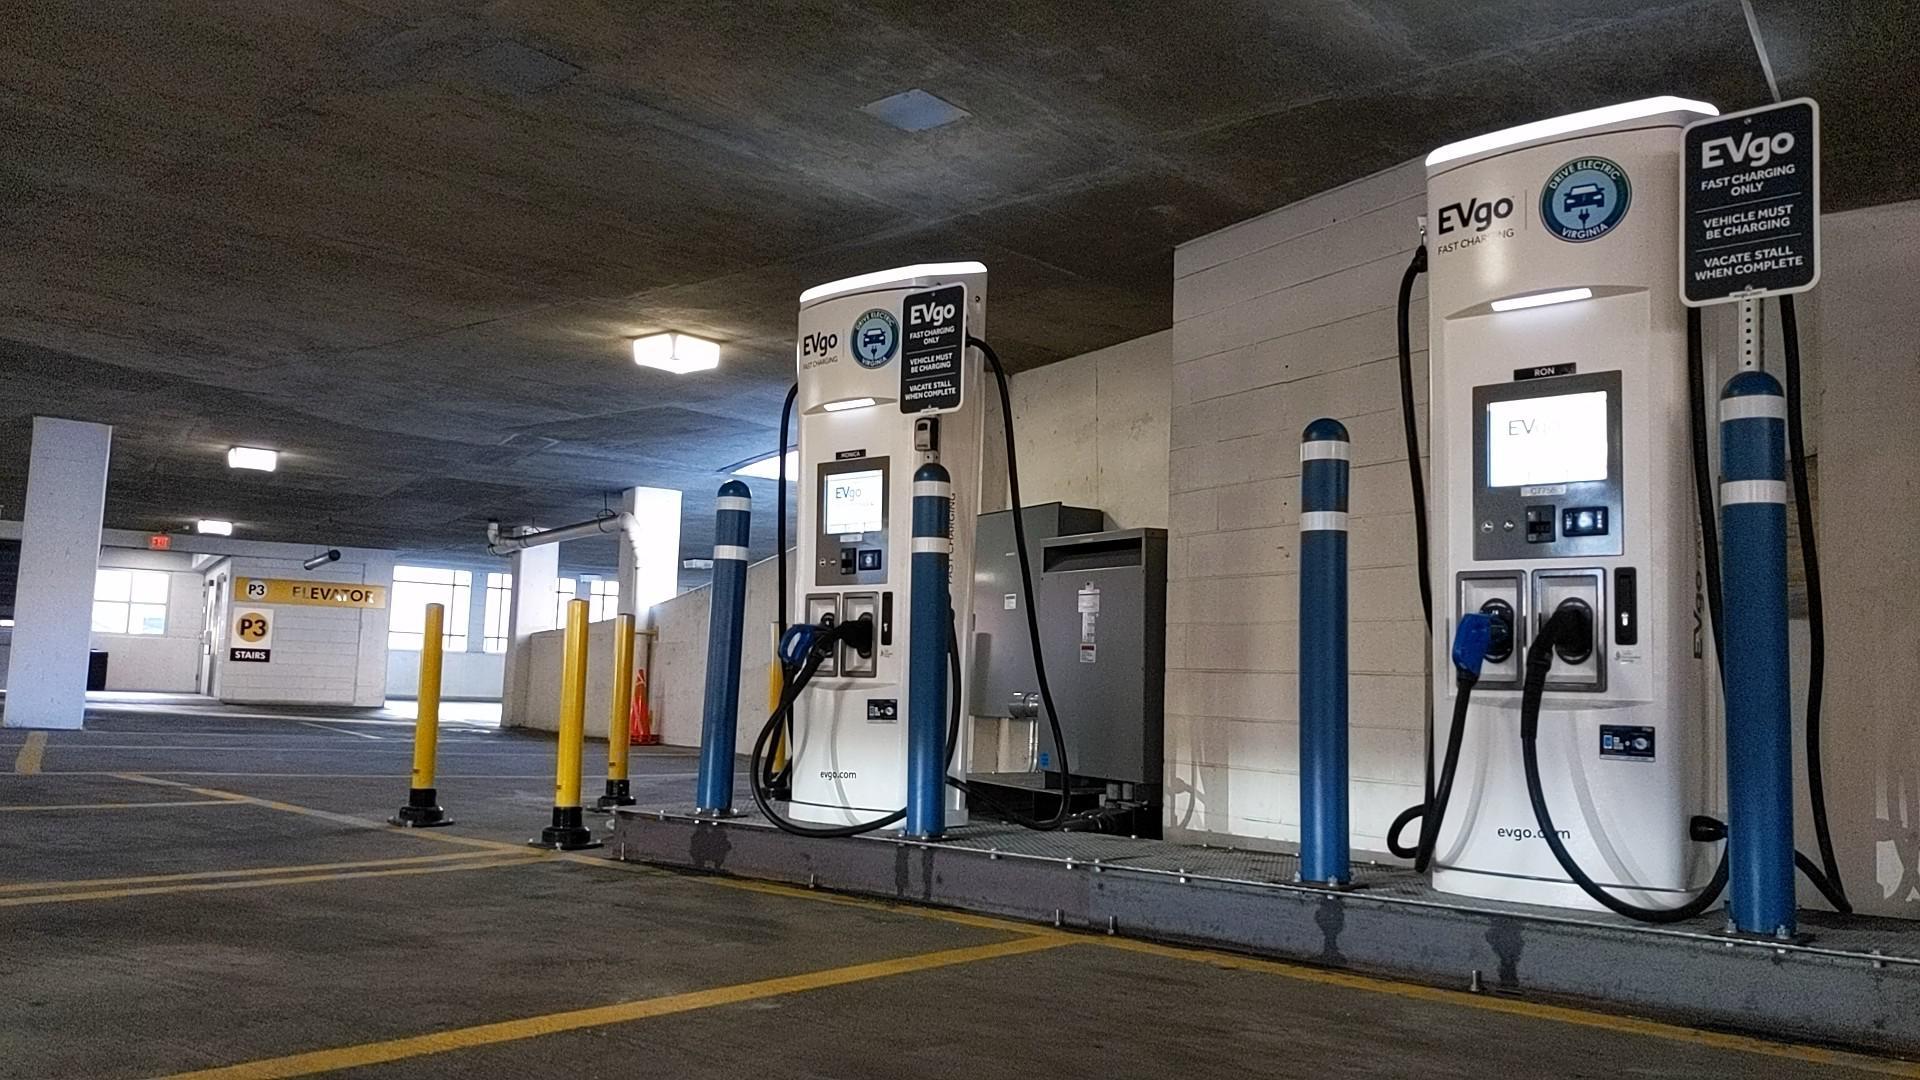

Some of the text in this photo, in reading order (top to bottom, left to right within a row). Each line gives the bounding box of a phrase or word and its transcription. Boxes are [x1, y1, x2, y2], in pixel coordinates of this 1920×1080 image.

[1702, 131, 1795, 169] EVgo
[1549, 160, 1621, 190] DRIVE ELECTRIC
[1701, 163, 1796, 191] FAST CHARGING
[1730, 181, 1764, 196] ONLY
[1438, 197, 1514, 235] EVgo
[1703, 204, 1794, 229] VEHICLE MUST
[1561, 223, 1609, 239] VIRGINIA
[1706, 217, 1790, 240] BE CHARGING
[1438, 241, 1459, 255] FAST
[1704, 245, 1794, 268] VACATE STALL
[1695, 256, 1804, 281] WHEN COMPLETE
[910, 302, 956, 326] EVgo
[909, 325, 955, 340] FAST CHARGING
[923, 336, 939, 345] ONLY
[803, 332, 838, 357] EVgo
[910, 352, 953, 366] VEHICLE MUST
[911, 361, 952, 374] BE CHARGING
[1534, 367, 1556, 377] RON
[909, 380, 952, 392] VACATE STALL
[923, 387, 957, 398] COMPLETE
[835, 486, 861, 501] EVgo
[248, 584, 374, 604] P3 ELEVATOR
[1693, 571, 1705, 659] EVgo
[240, 618, 266, 637] P3
[234, 650, 266, 660] STAIRS
[820, 771, 857, 780] evgo.com
[1497, 827, 1571, 841] evgo.cm
